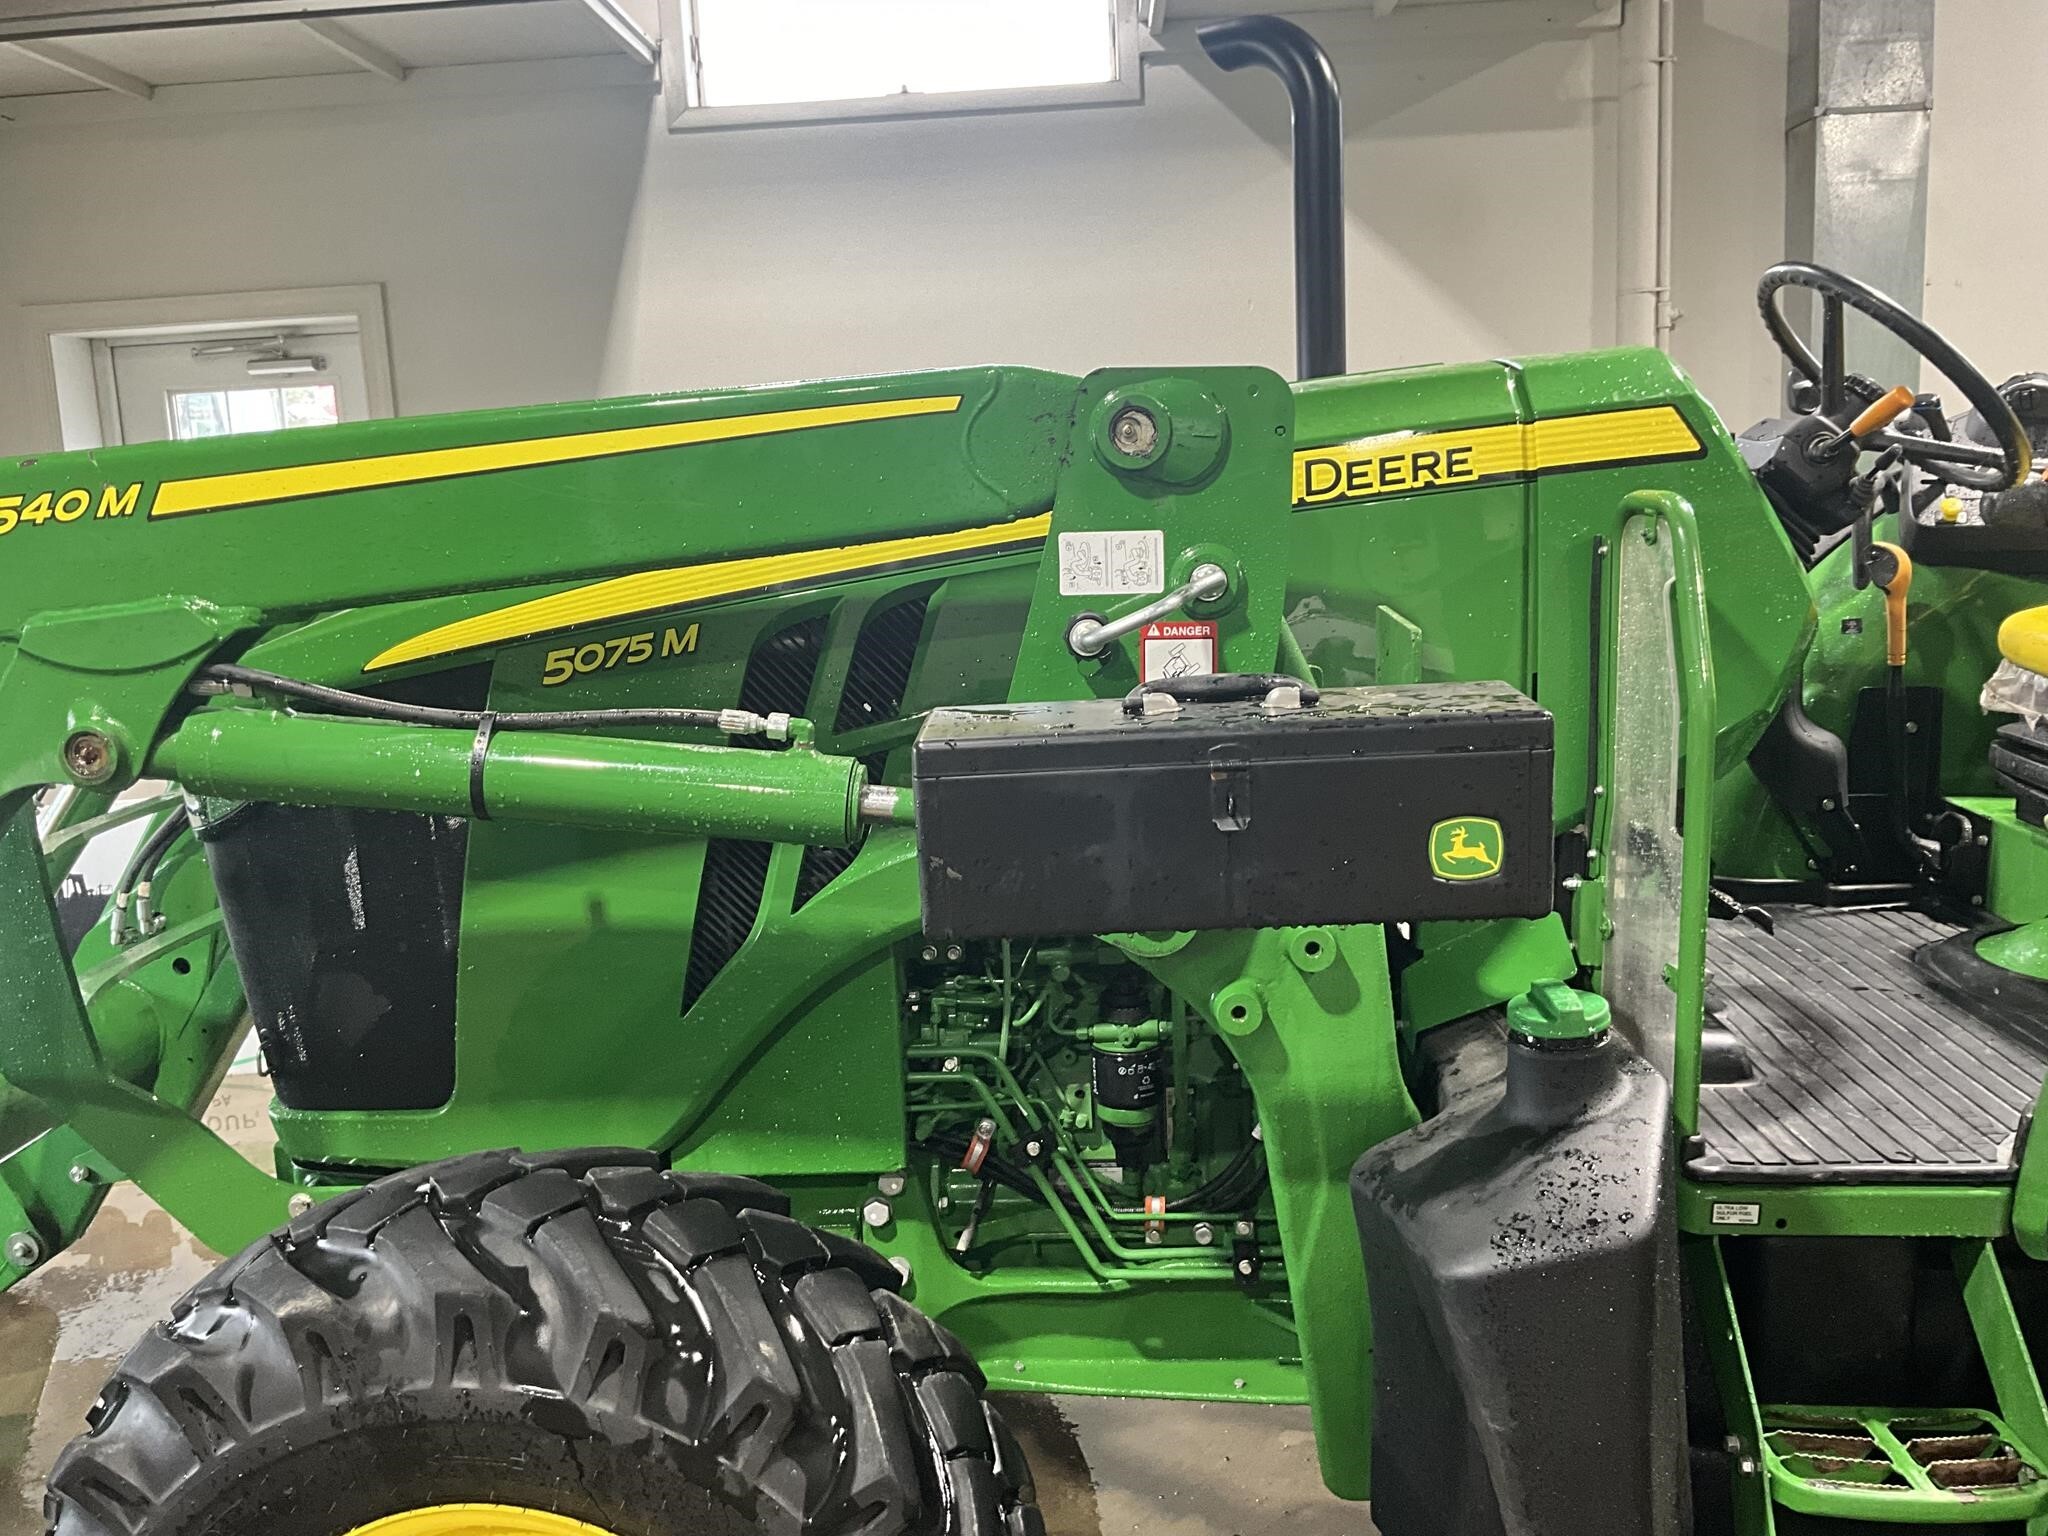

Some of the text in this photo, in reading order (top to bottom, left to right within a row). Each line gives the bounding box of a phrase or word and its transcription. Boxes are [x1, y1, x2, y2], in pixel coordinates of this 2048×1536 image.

[1304, 446, 1473, 497] DEERE
[95, 481, 144, 519] M
[1163, 626, 1211, 636] DANGER
[542, 623, 699, 686] 5075 M
